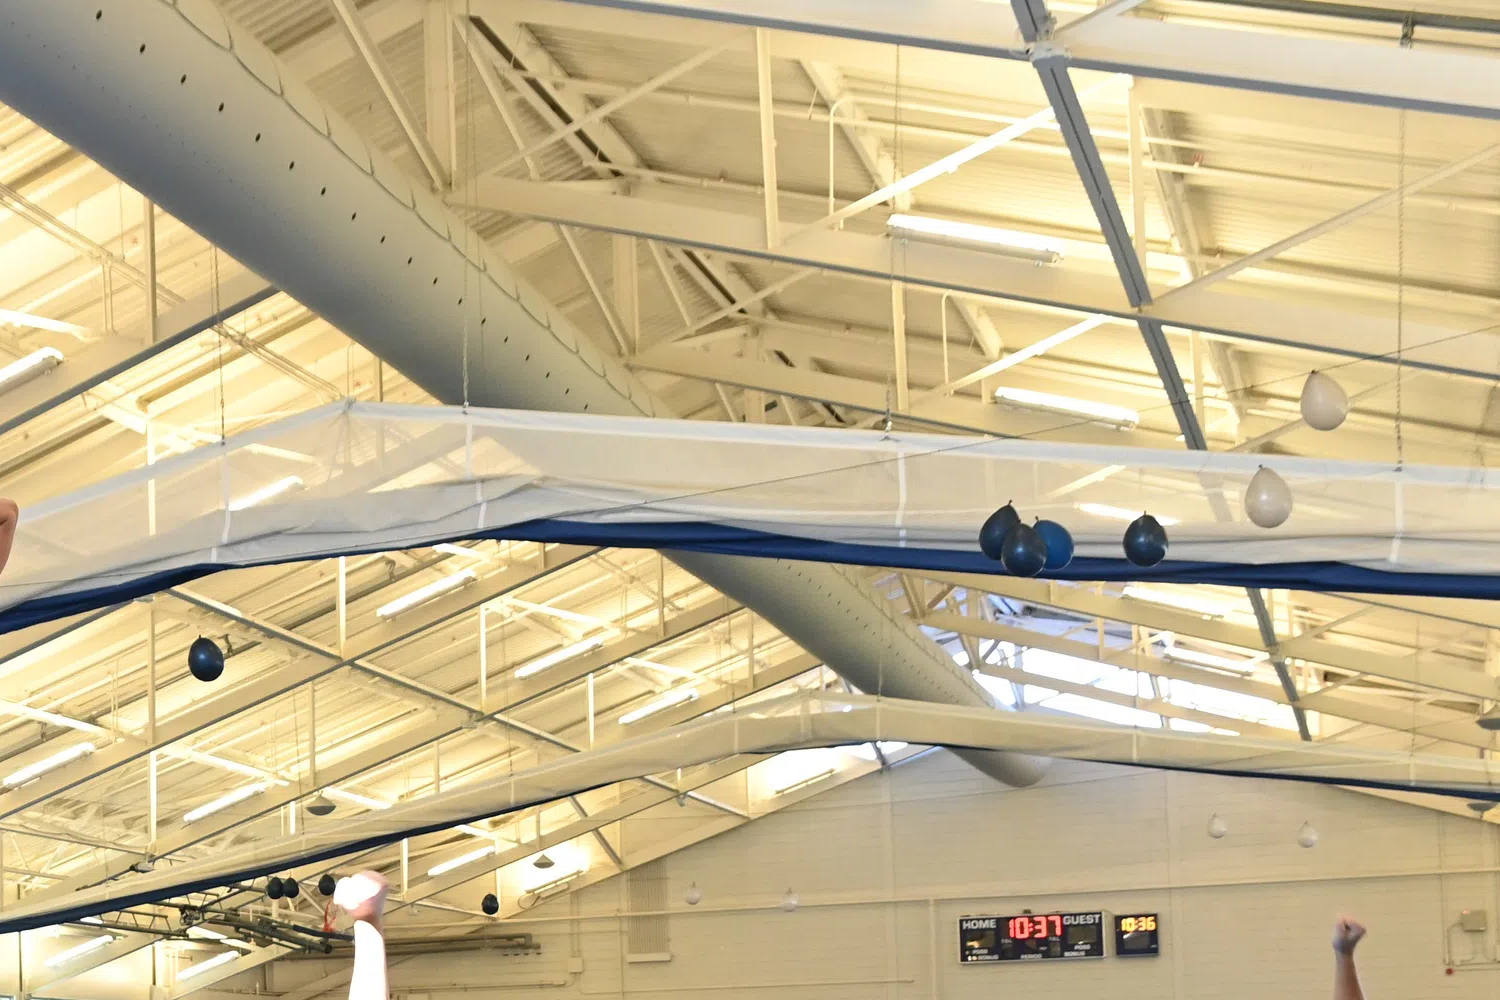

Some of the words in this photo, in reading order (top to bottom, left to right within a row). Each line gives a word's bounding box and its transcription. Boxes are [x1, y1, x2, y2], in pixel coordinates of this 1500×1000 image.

[962, 919, 997, 930] HOME
[1062, 914, 1101, 925] GUEST
[1120, 916, 1156, 932] 10:36
[1008, 915, 1062, 939] 10:37
